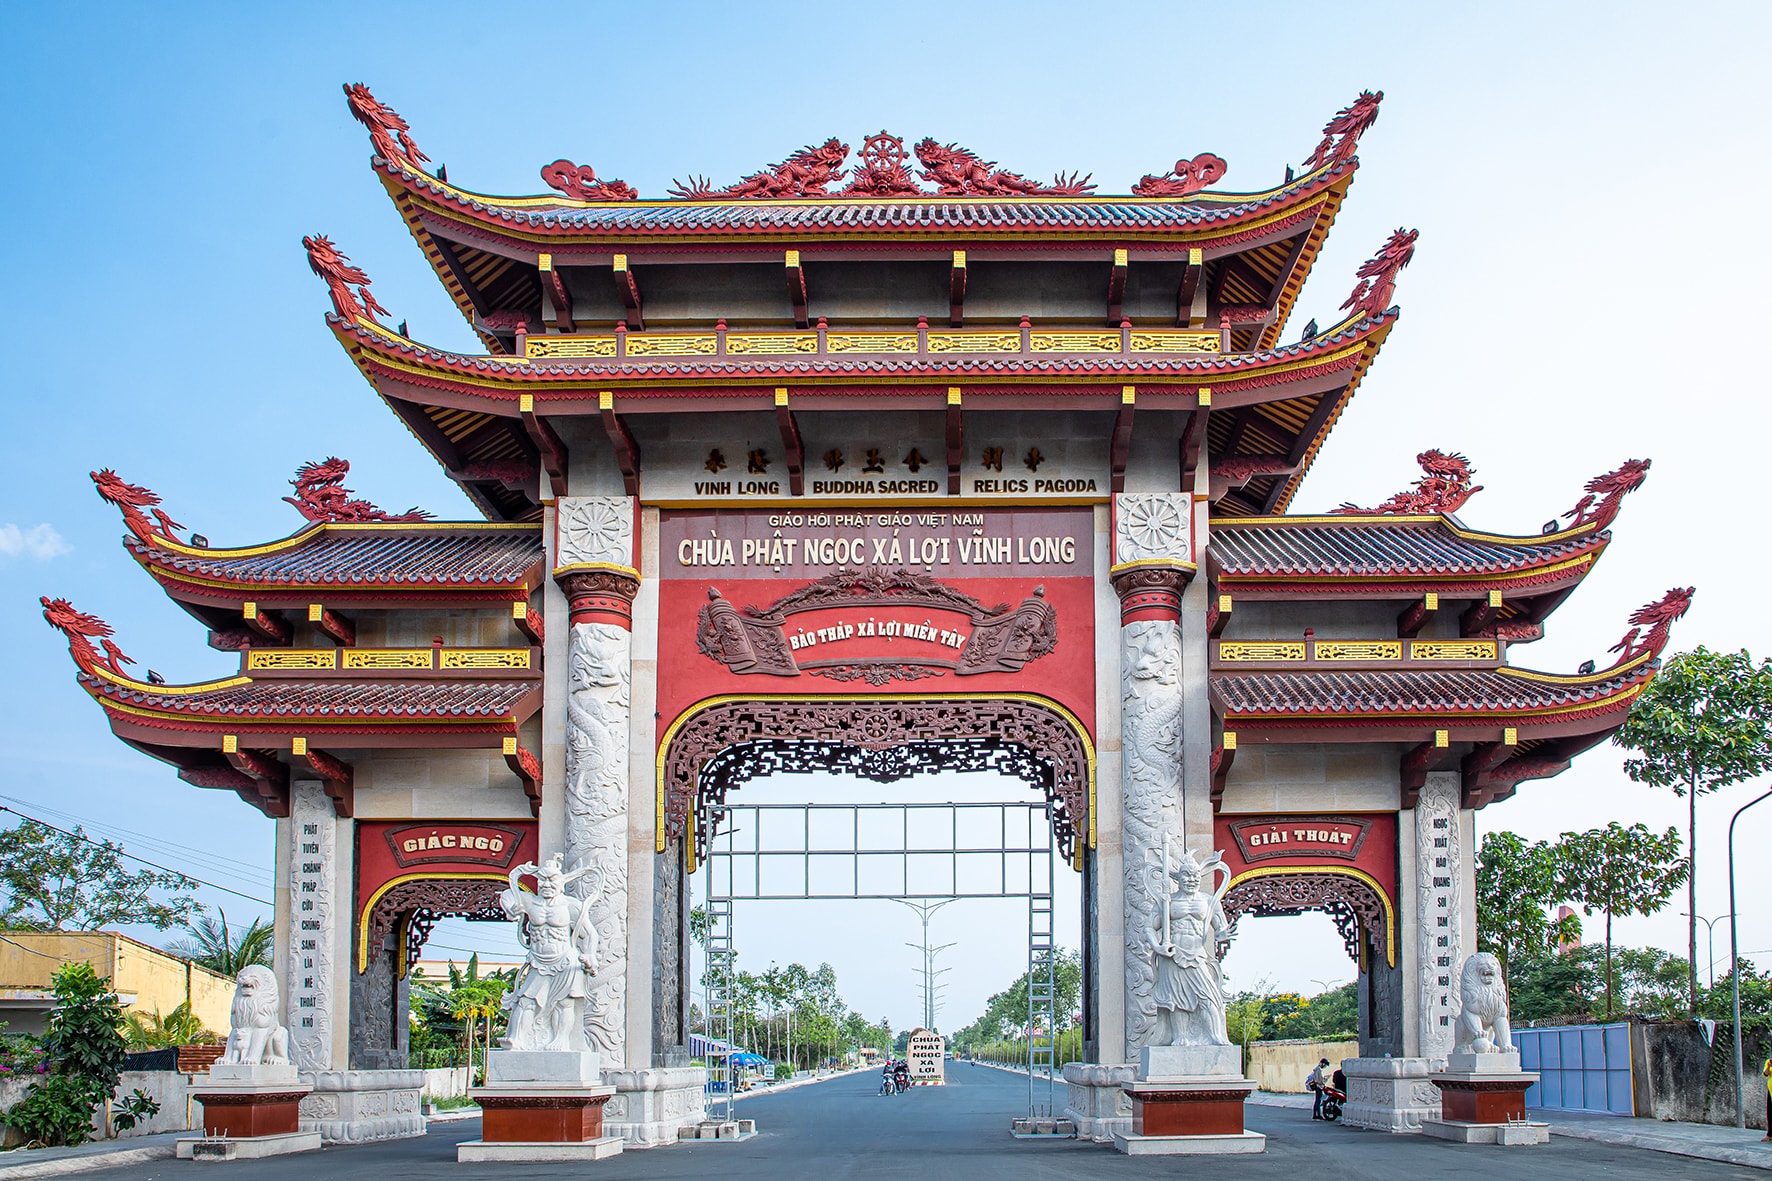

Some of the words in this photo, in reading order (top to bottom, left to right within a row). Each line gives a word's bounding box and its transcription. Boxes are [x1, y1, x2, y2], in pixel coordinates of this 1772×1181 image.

[694, 481, 731, 495] VINH
[738, 481, 780, 495] LONG
[813, 481, 875, 494] BUDDHA
[878, 480, 939, 494] SACRED
[974, 479, 1029, 493] RELICS
[1035, 479, 1097, 493] PAGODA
[768, 511, 804, 527] GIÁO
[835, 512, 874, 529] PHẬT
[877, 510, 913, 527] GIÁO
[917, 511, 948, 528] VIỆT
[952, 514, 984, 525] NAM
[678, 529, 735, 566] CHÙA
[742, 529, 797, 571] PHẬT
[804, 538, 865, 571] NGỌC
[872, 529, 903, 565] XÁ
[909, 537, 950, 570] LỢI
[957, 528, 1012, 564] VĨNH
[1018, 536, 1076, 564] LONG
[789, 627, 817, 650] BẢO
[878, 619, 900, 642] LỢI
[903, 618, 938, 642] MIỀN
[940, 628, 966, 650] TÂY
[403, 830, 456, 853] GIÁC
[460, 834, 504, 857] NGỘ
[1250, 826, 1288, 846] GIẢI
[1294, 826, 1353, 845] THOÁT
